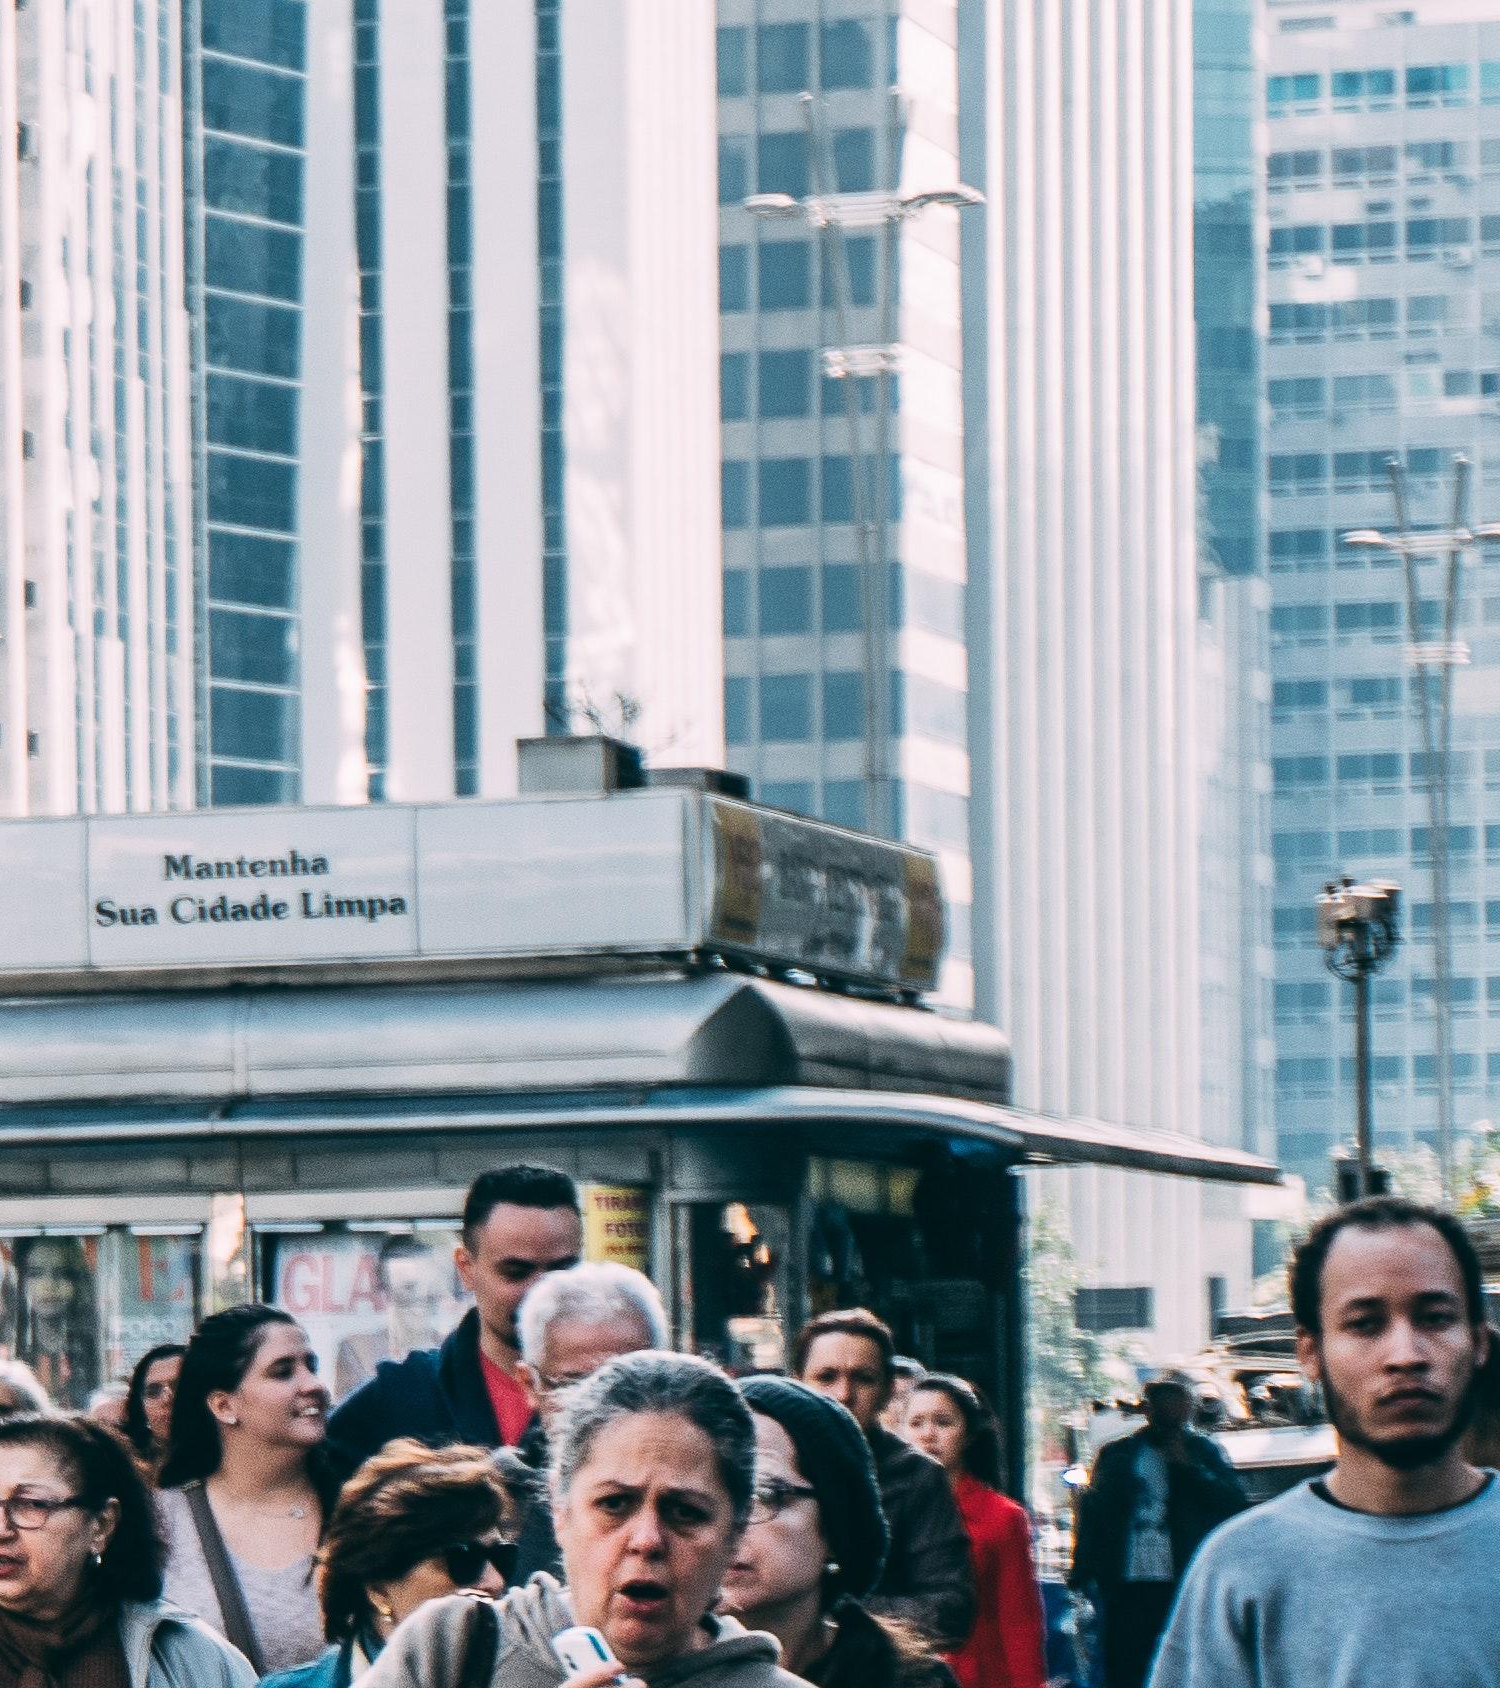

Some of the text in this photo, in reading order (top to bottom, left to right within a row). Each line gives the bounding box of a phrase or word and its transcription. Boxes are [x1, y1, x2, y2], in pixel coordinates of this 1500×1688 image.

[163, 850, 330, 880] Mantenha
[96, 891, 407, 926] Sua Cidade Limpa
